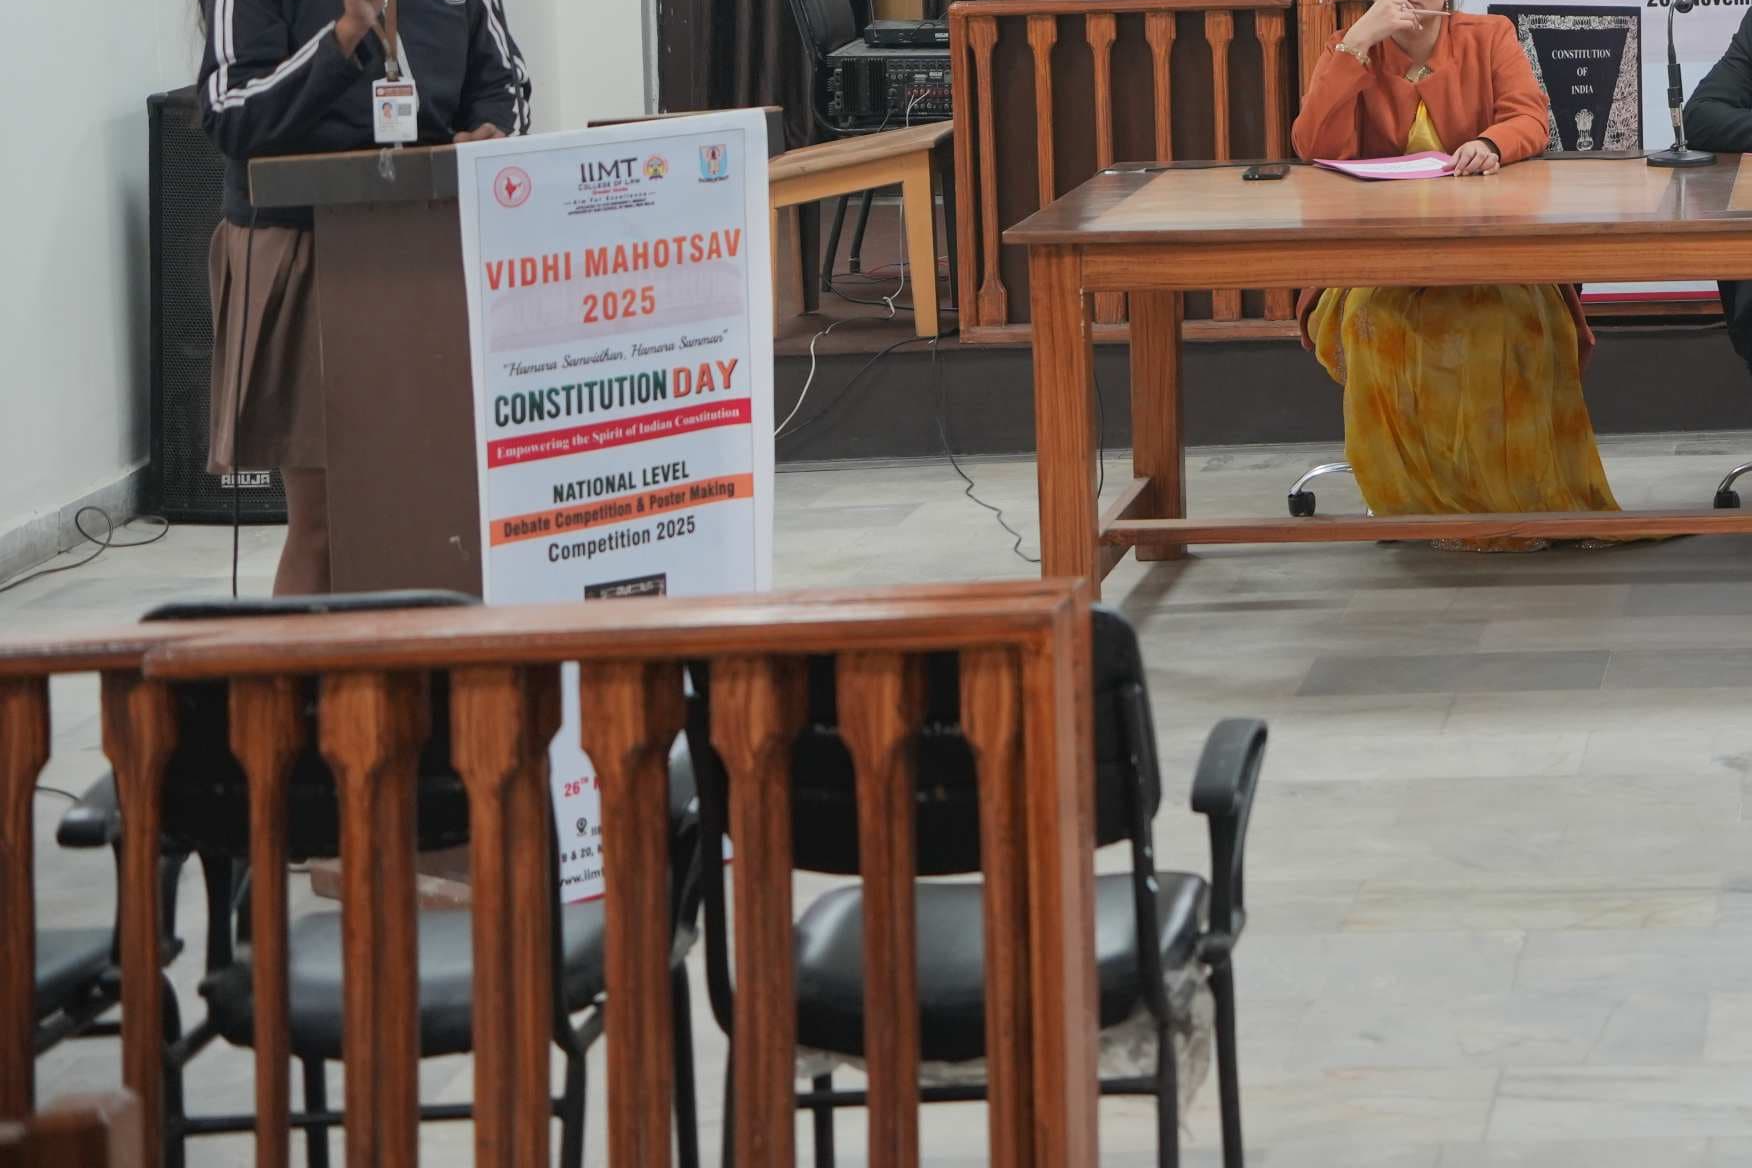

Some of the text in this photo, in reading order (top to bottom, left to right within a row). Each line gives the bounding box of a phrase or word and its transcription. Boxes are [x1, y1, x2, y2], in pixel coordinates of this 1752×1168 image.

[1551, 48, 1612, 60] CONSTITUTION
[1577, 67, 1588, 77] OF
[1571, 85, 1594, 95] INDIA
[580, 157, 638, 183] IIMT
[486, 228, 741, 291] VIDHI MAHOTSAV
[583, 285, 656, 324] 2025
[494, 358, 739, 428] CONSTITUTION DAY
[496, 406, 740, 460] Empowering the Spirit of Indian Constitution
[553, 460, 690, 504] NATIONAL LEVEL
[503, 481, 735, 538] Debate Competition & Poster Making
[548, 515, 696, 562] Competition 2025
